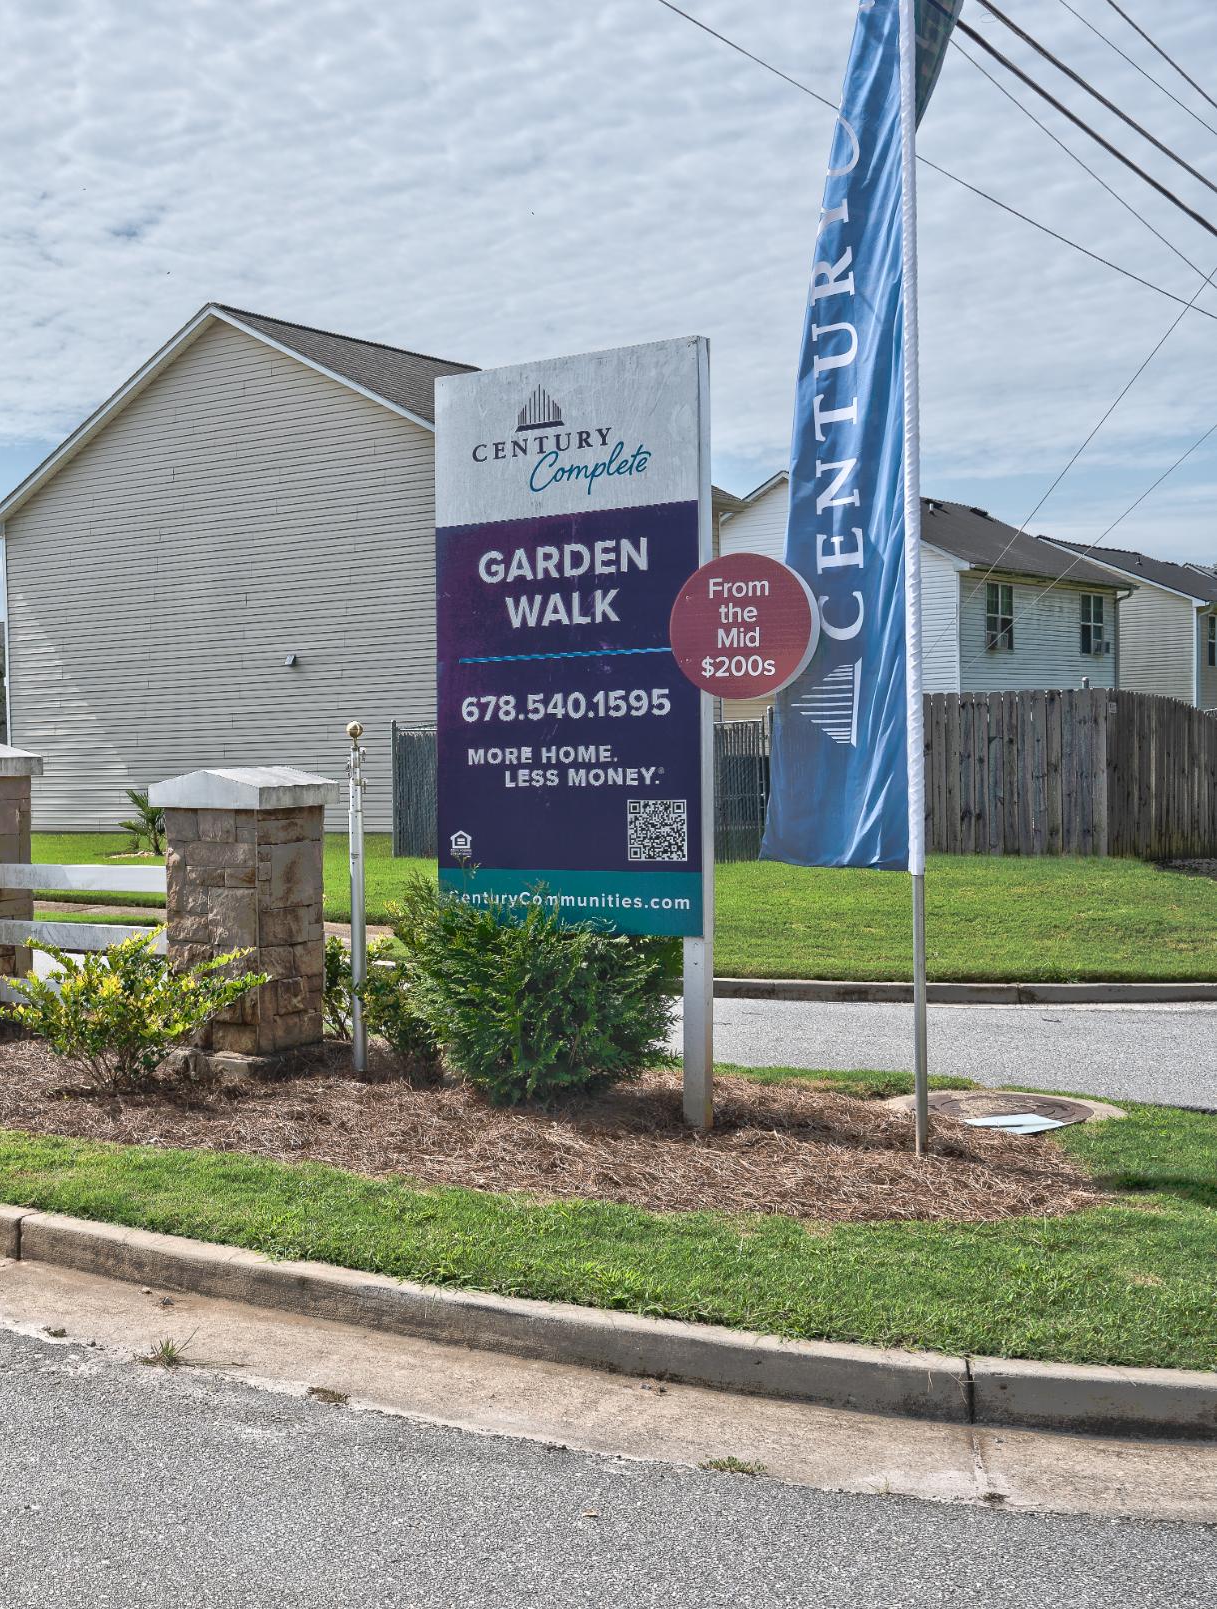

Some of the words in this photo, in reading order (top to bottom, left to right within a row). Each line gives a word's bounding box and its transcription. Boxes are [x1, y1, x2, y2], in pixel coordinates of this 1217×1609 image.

[472, 427, 612, 463] CENTURY
[529, 441, 651, 495] Complete
[478, 537, 649, 584] GARDEN
[708, 578, 769, 598] From
[505, 588, 621, 629] WALK
[719, 603, 757, 623] the
[717, 627, 760, 648] Mid
[701, 655, 776, 678] $200s
[461, 688, 671, 722] 678.540.1595
[467, 747, 532, 765] MORE
[541, 745, 618, 763] HOME.
[505, 769, 559, 787] LESS
